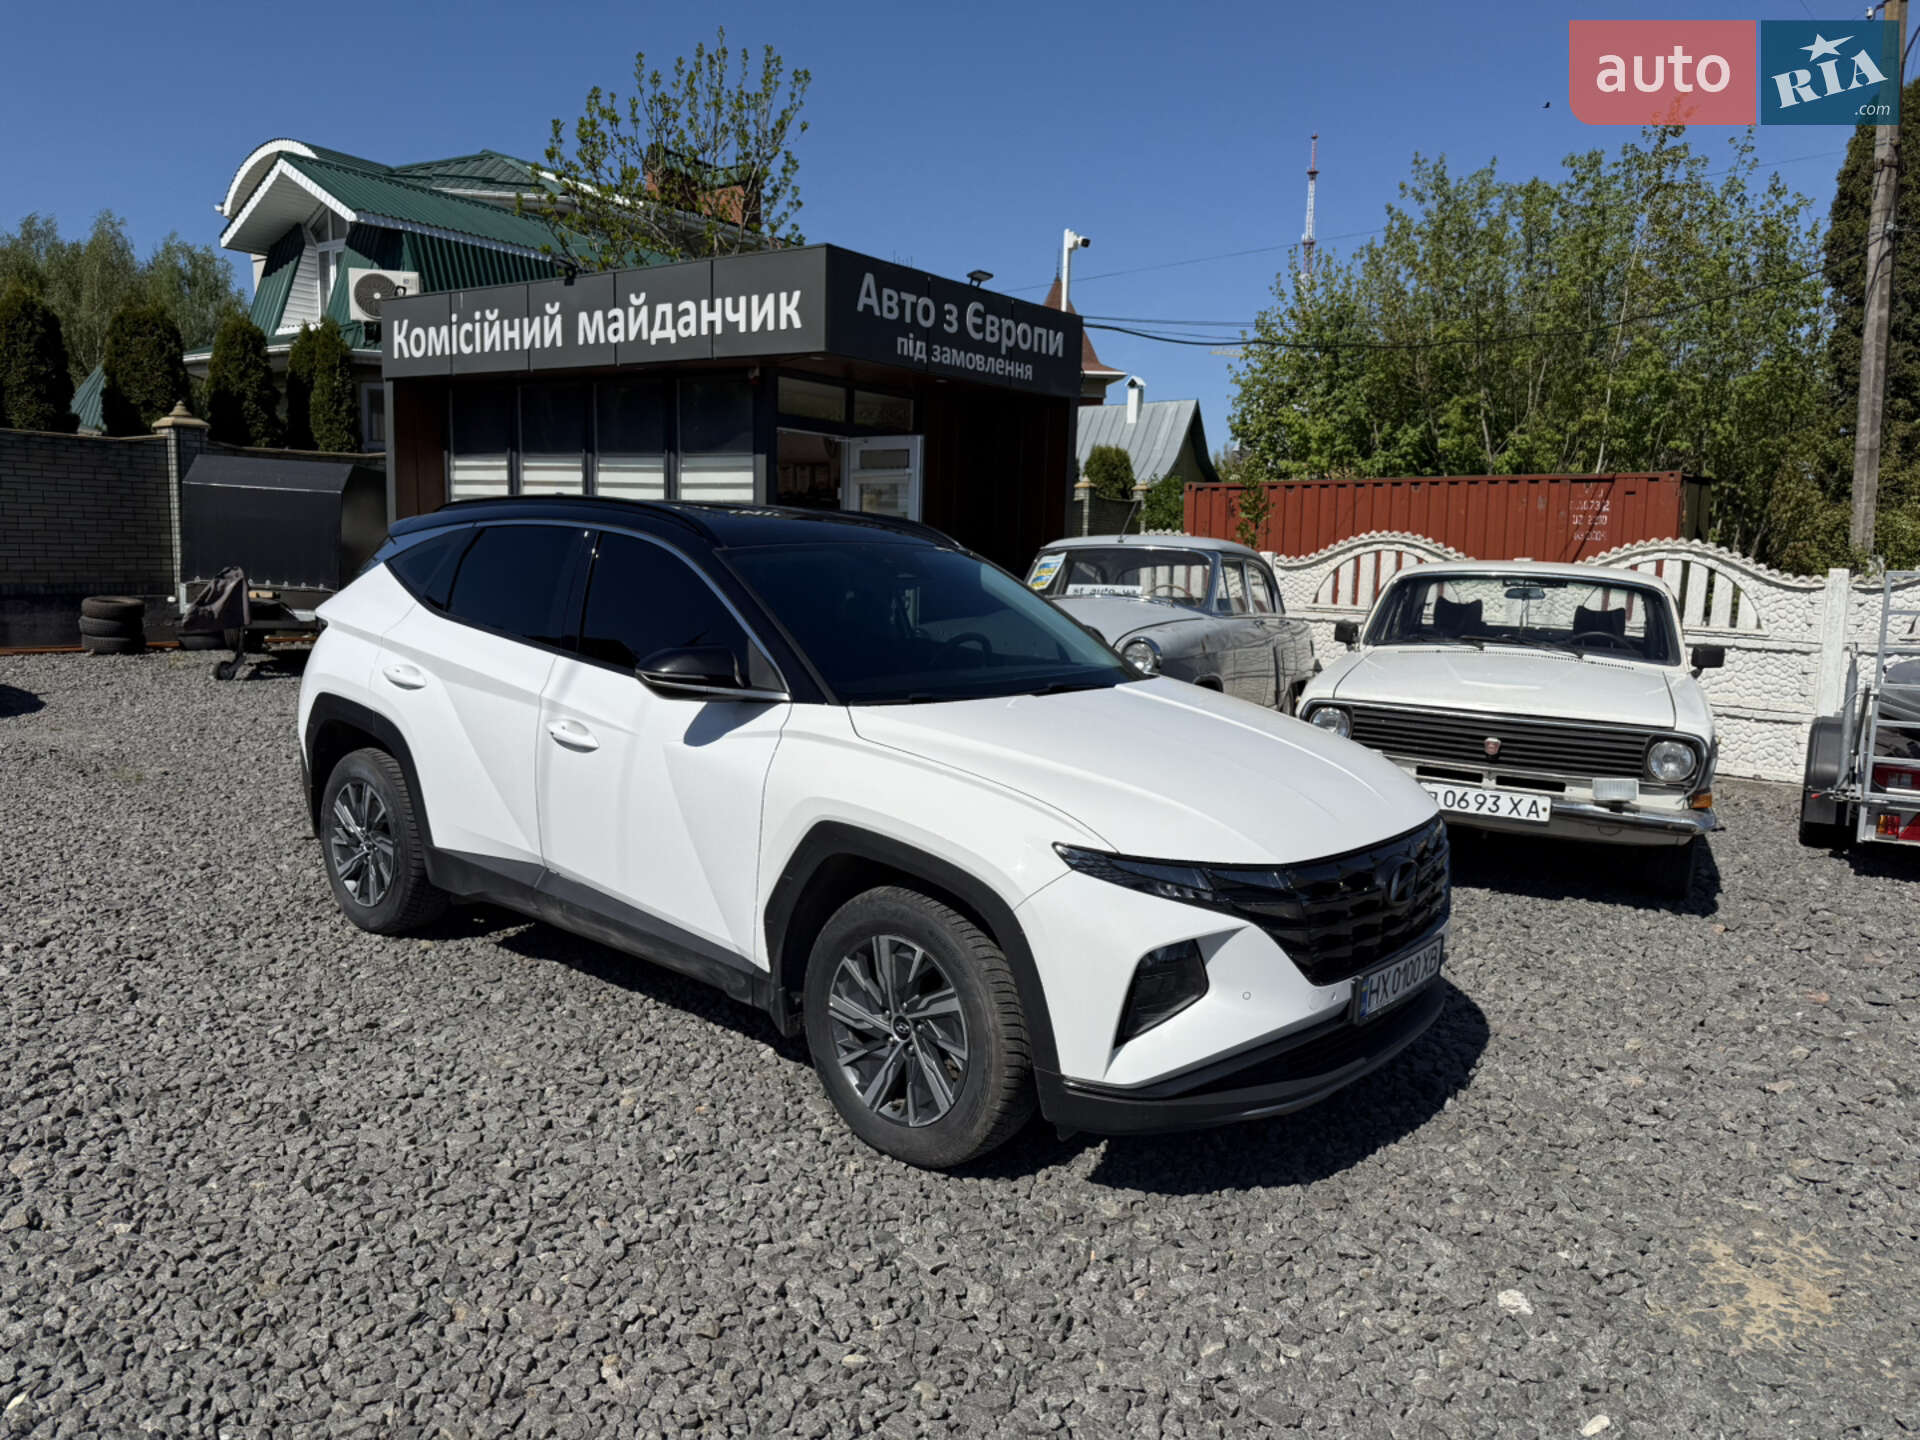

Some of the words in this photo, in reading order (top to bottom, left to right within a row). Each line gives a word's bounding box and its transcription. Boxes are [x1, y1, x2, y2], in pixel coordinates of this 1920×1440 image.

[392, 302, 563, 360] Комісійний
[577, 290, 802, 346] майданчик
[856, 272, 936, 328] Авто
[943, 303, 958, 334] з
[966, 301, 1064, 358] Європи
[896, 333, 928, 364] під
[931, 344, 1033, 381] замовлення
[1443, 790, 1501, 813] 0693
